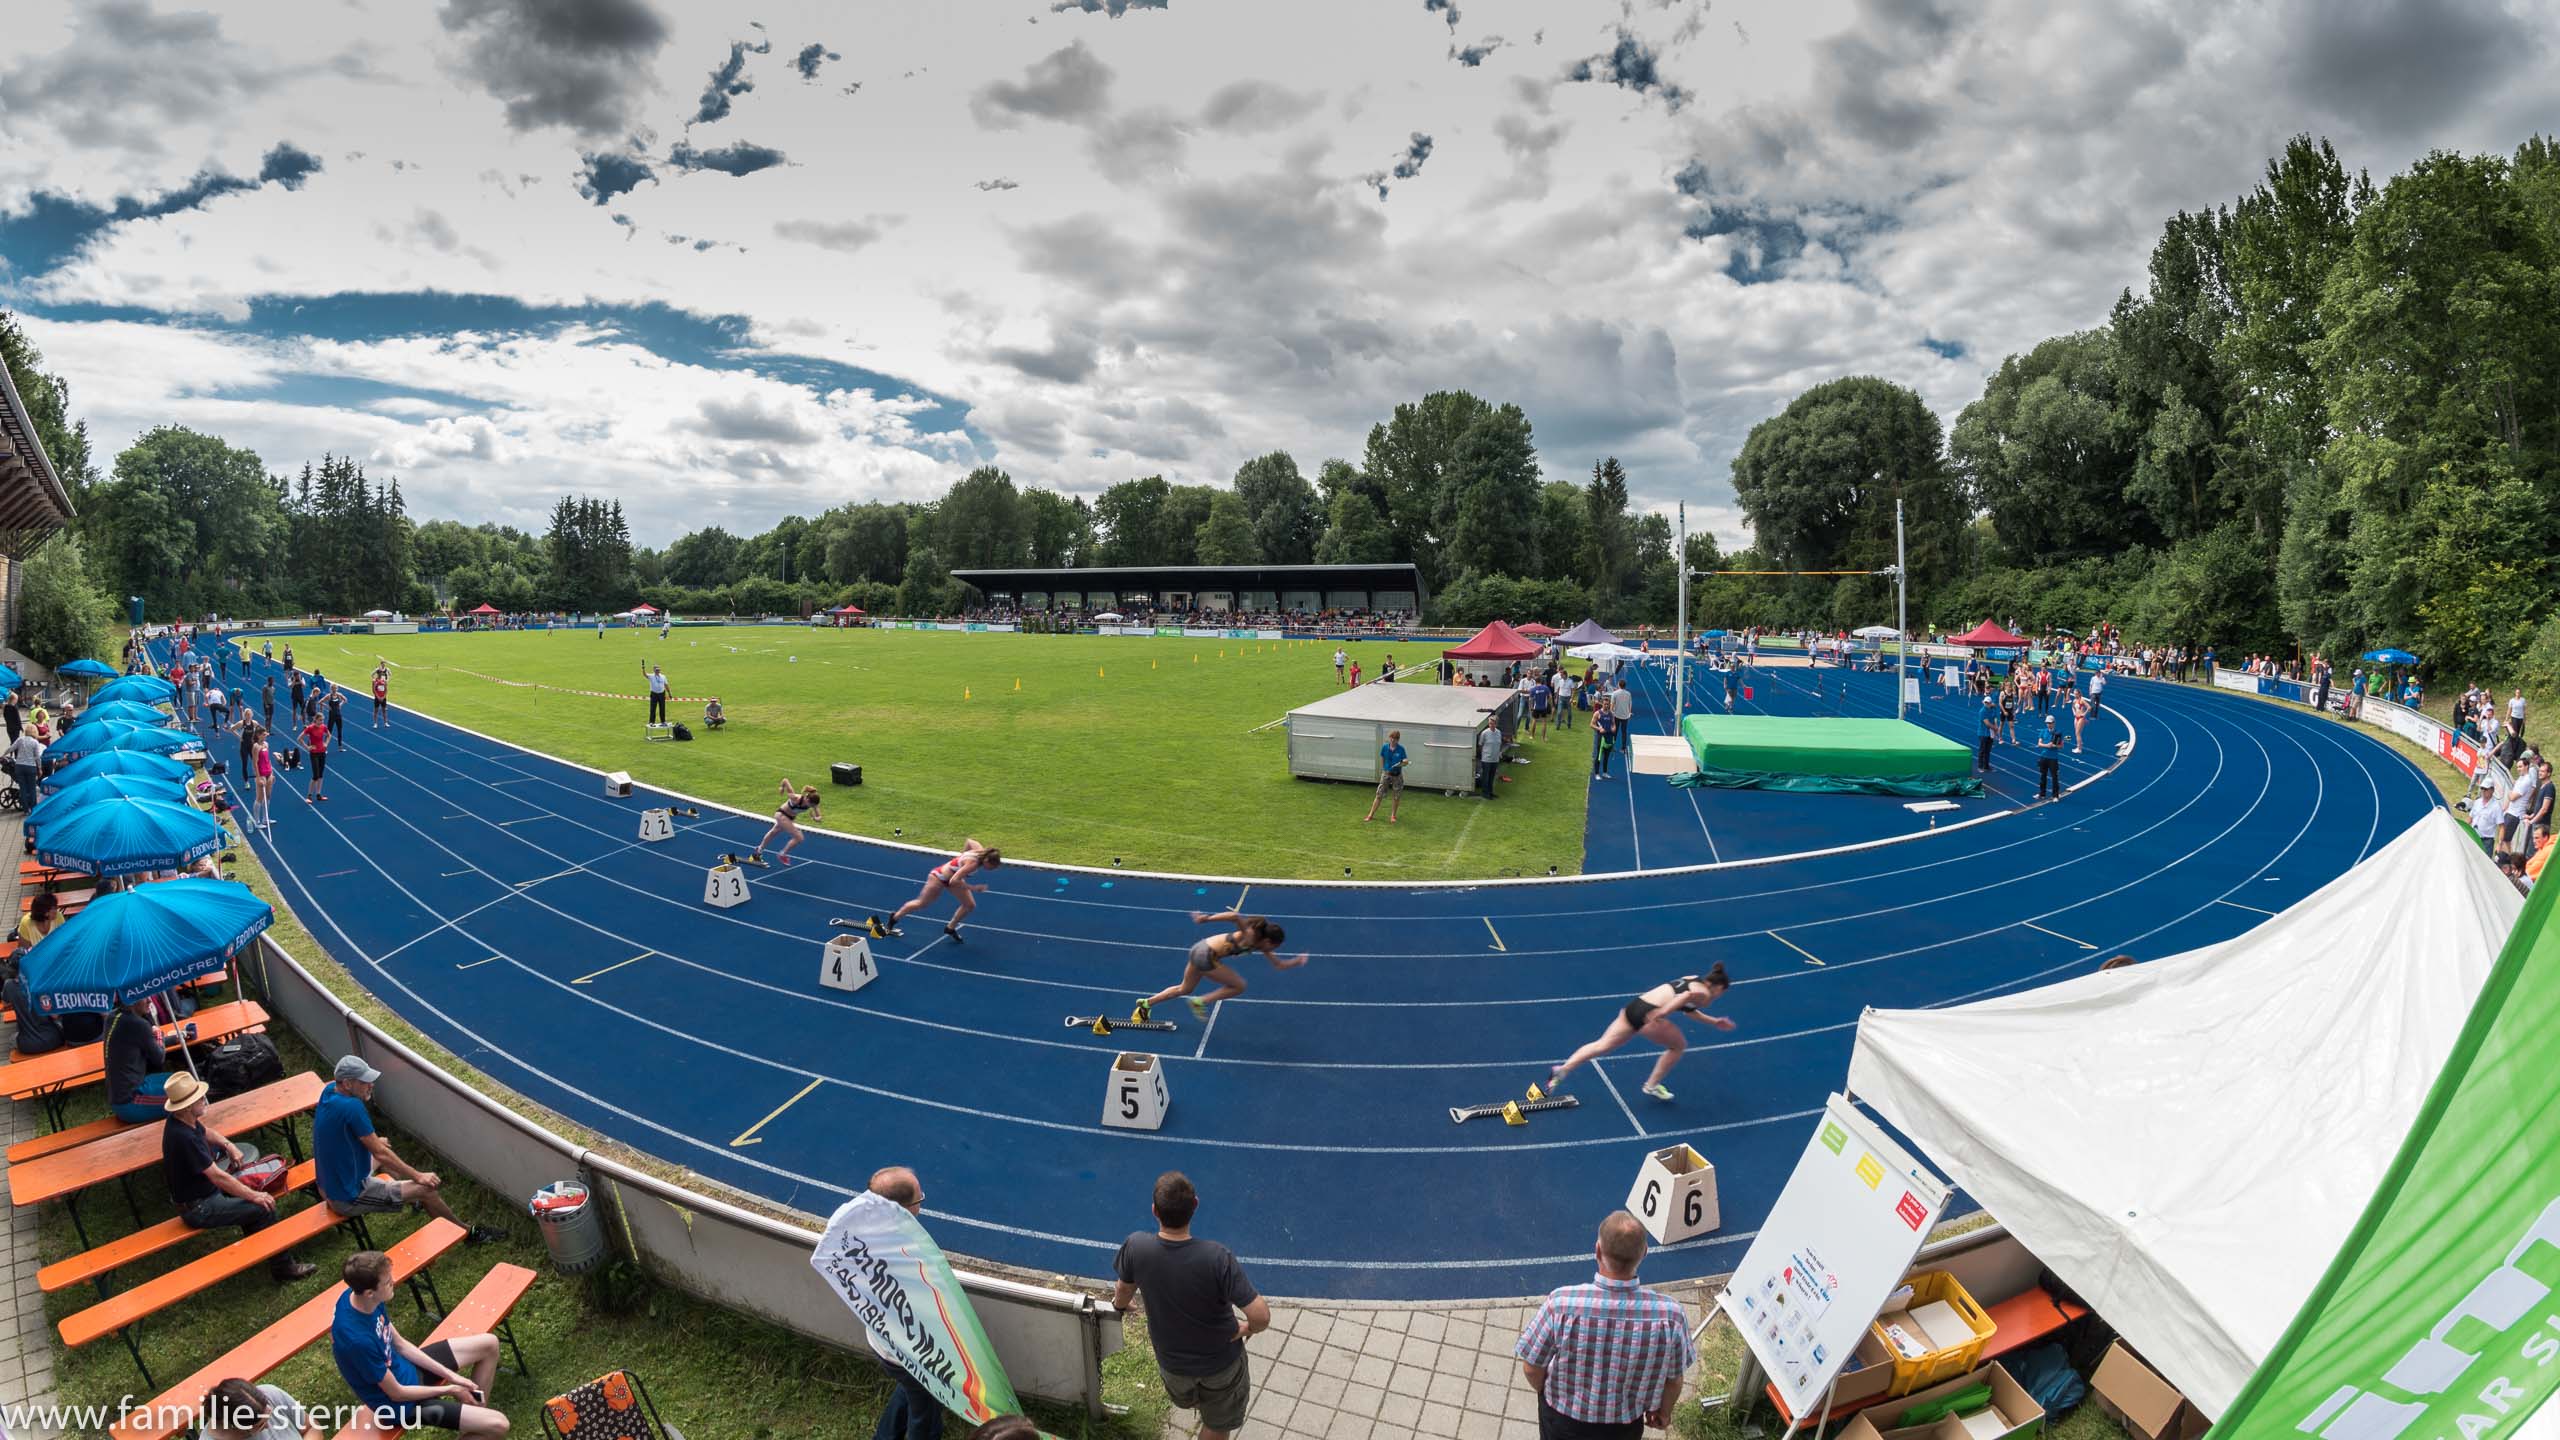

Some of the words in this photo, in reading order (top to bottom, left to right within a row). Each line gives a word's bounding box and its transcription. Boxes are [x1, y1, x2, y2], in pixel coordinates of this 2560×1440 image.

[644, 820, 650, 836] 2
[658, 819, 668, 835] 2
[53, 853, 94, 874] ERDINGER
[104, 858, 174, 872] ALKOHOLFREI
[711, 878, 720, 898] 3
[731, 878, 741, 897] 3
[235, 915, 267, 949] ERDINGER
[832, 957, 842, 982] 4
[860, 952, 868, 976] 4
[126, 956, 218, 999] ALKOHOLFREI
[54, 992, 109, 1010] ERDINGER
[1155, 1073, 1165, 1107] 5
[1121, 1086, 1139, 1119] 5
[1643, 1180, 1661, 1217] 6
[1684, 1189, 1702, 1227] 6
[2438, 1376, 2525, 1440] AR
